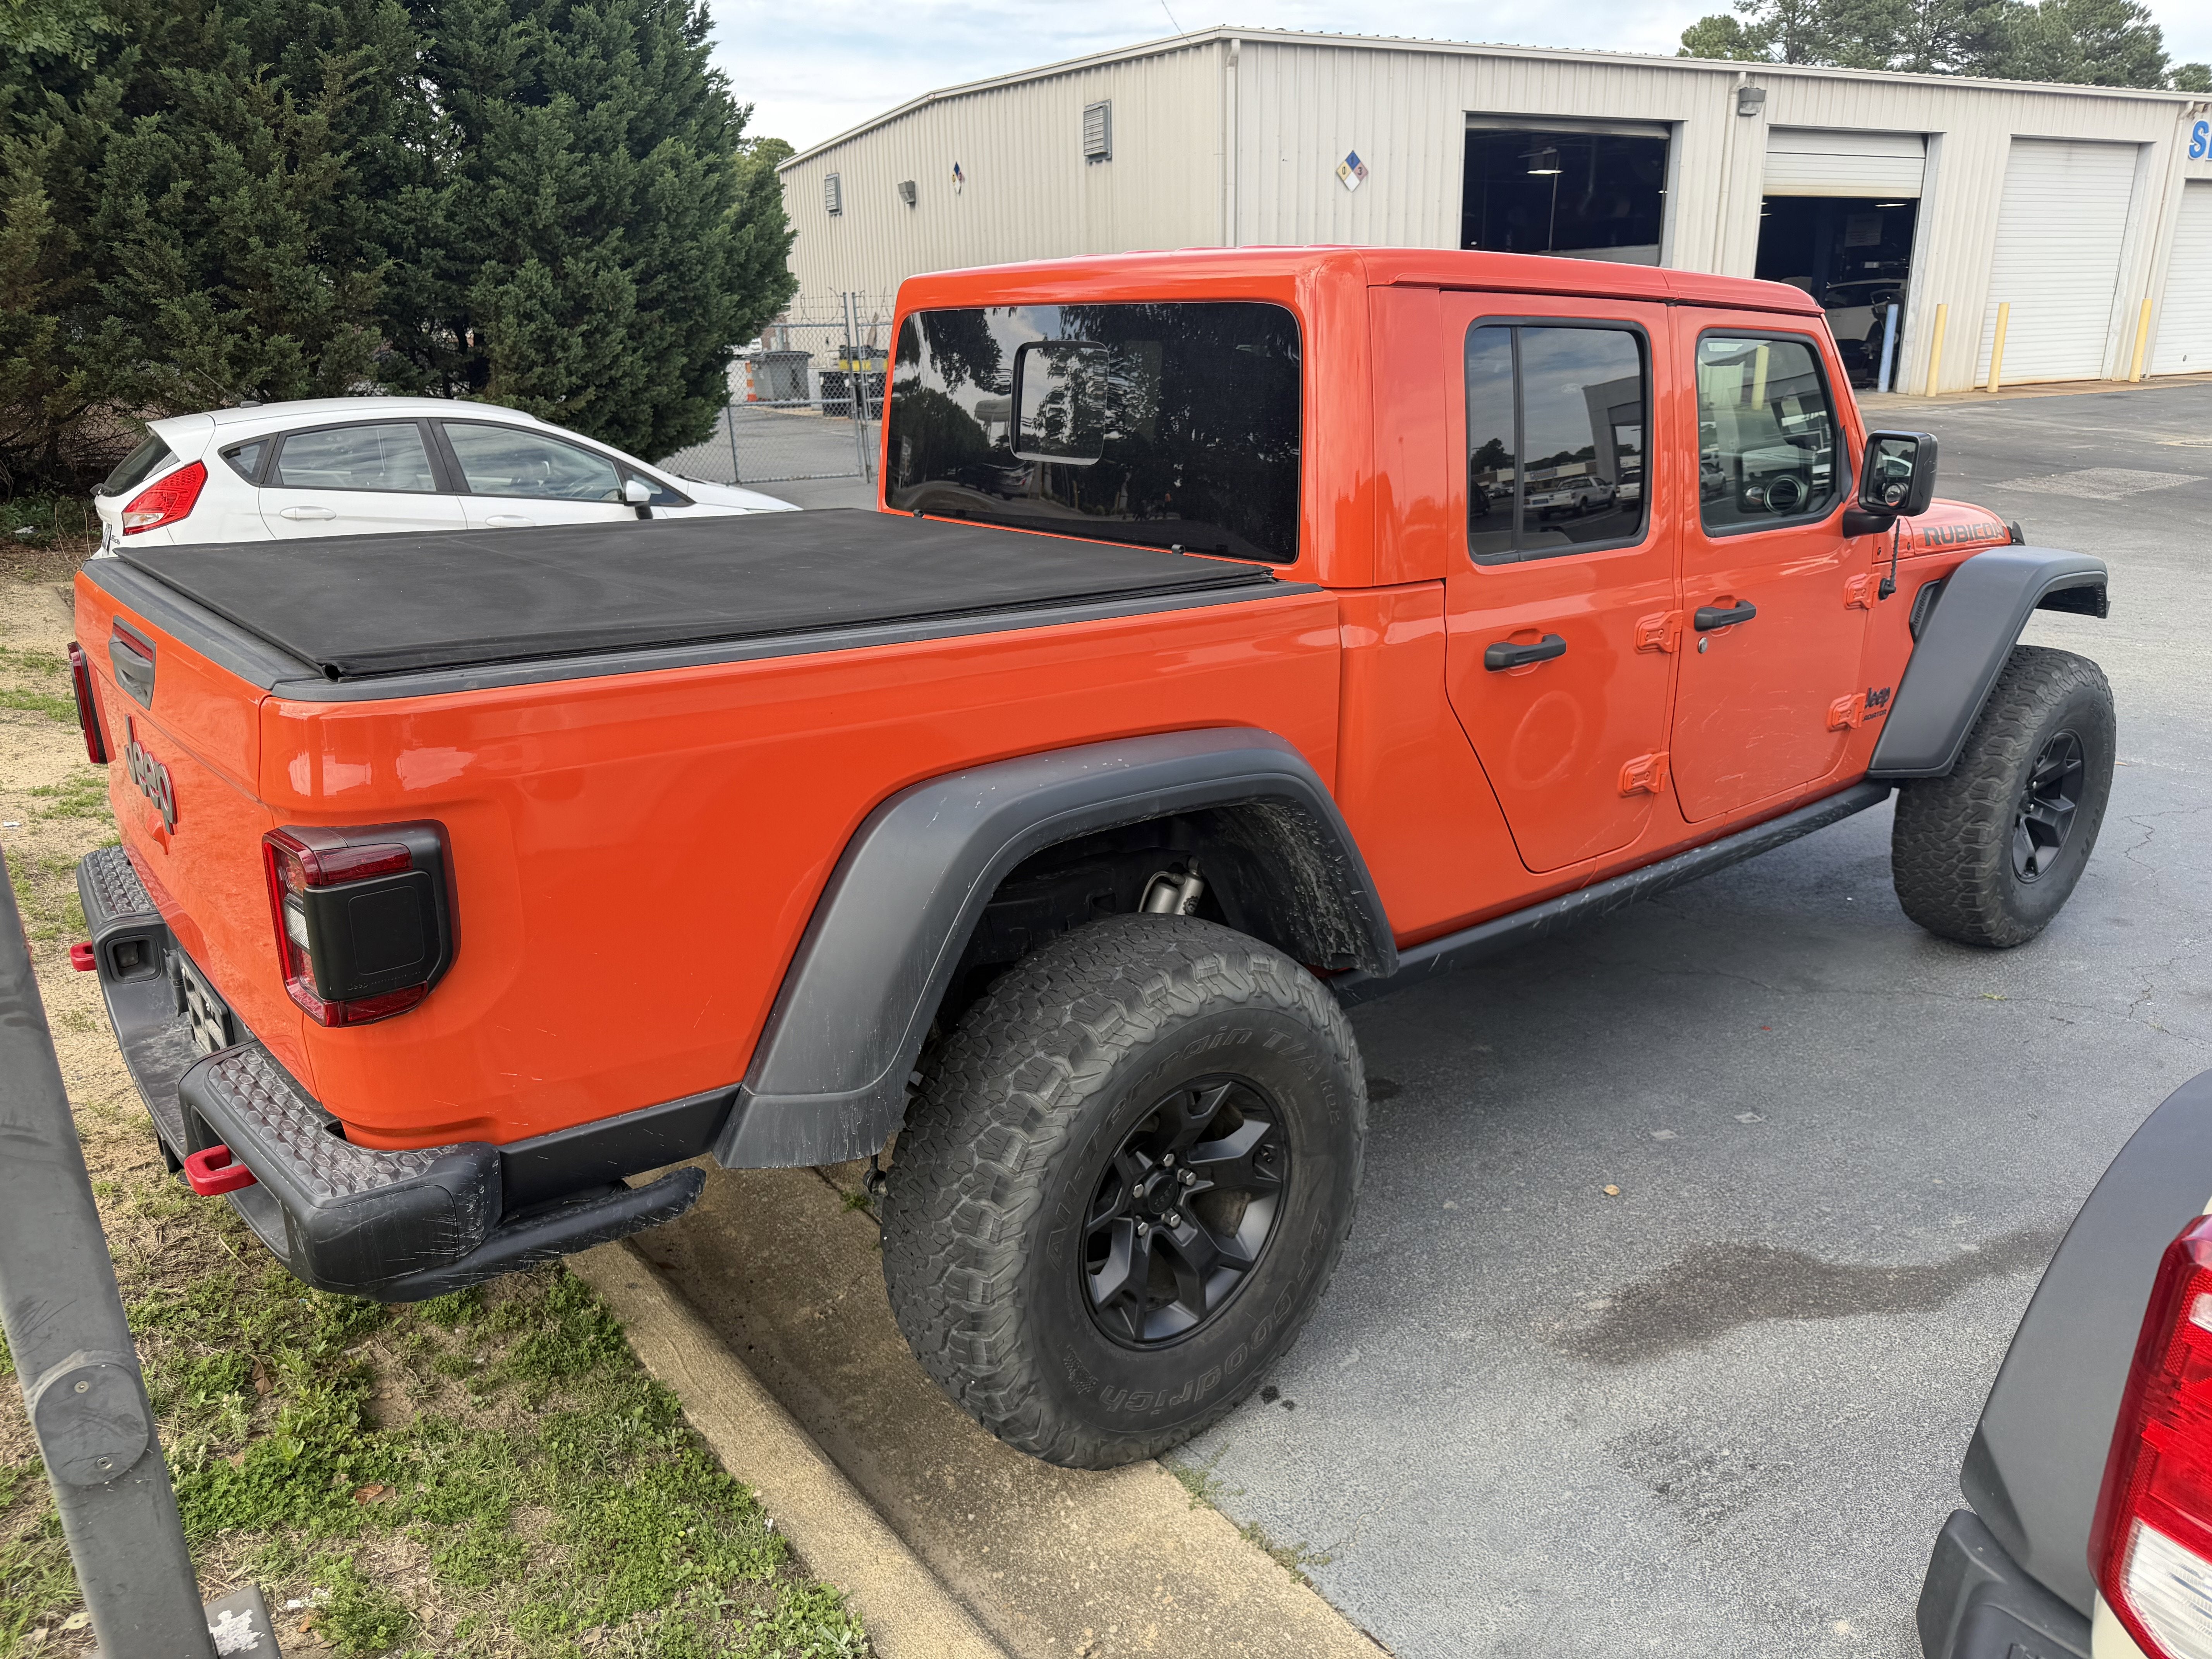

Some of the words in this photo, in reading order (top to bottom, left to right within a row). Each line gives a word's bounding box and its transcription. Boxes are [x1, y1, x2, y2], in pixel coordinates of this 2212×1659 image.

[2188, 120, 2212, 160] S
[1923, 522, 2005, 546] RUBICON
[1865, 687, 1890, 709] Jeep
[124, 713, 178, 835] Jeep
[1262, 1027, 1323, 1081] T/A
